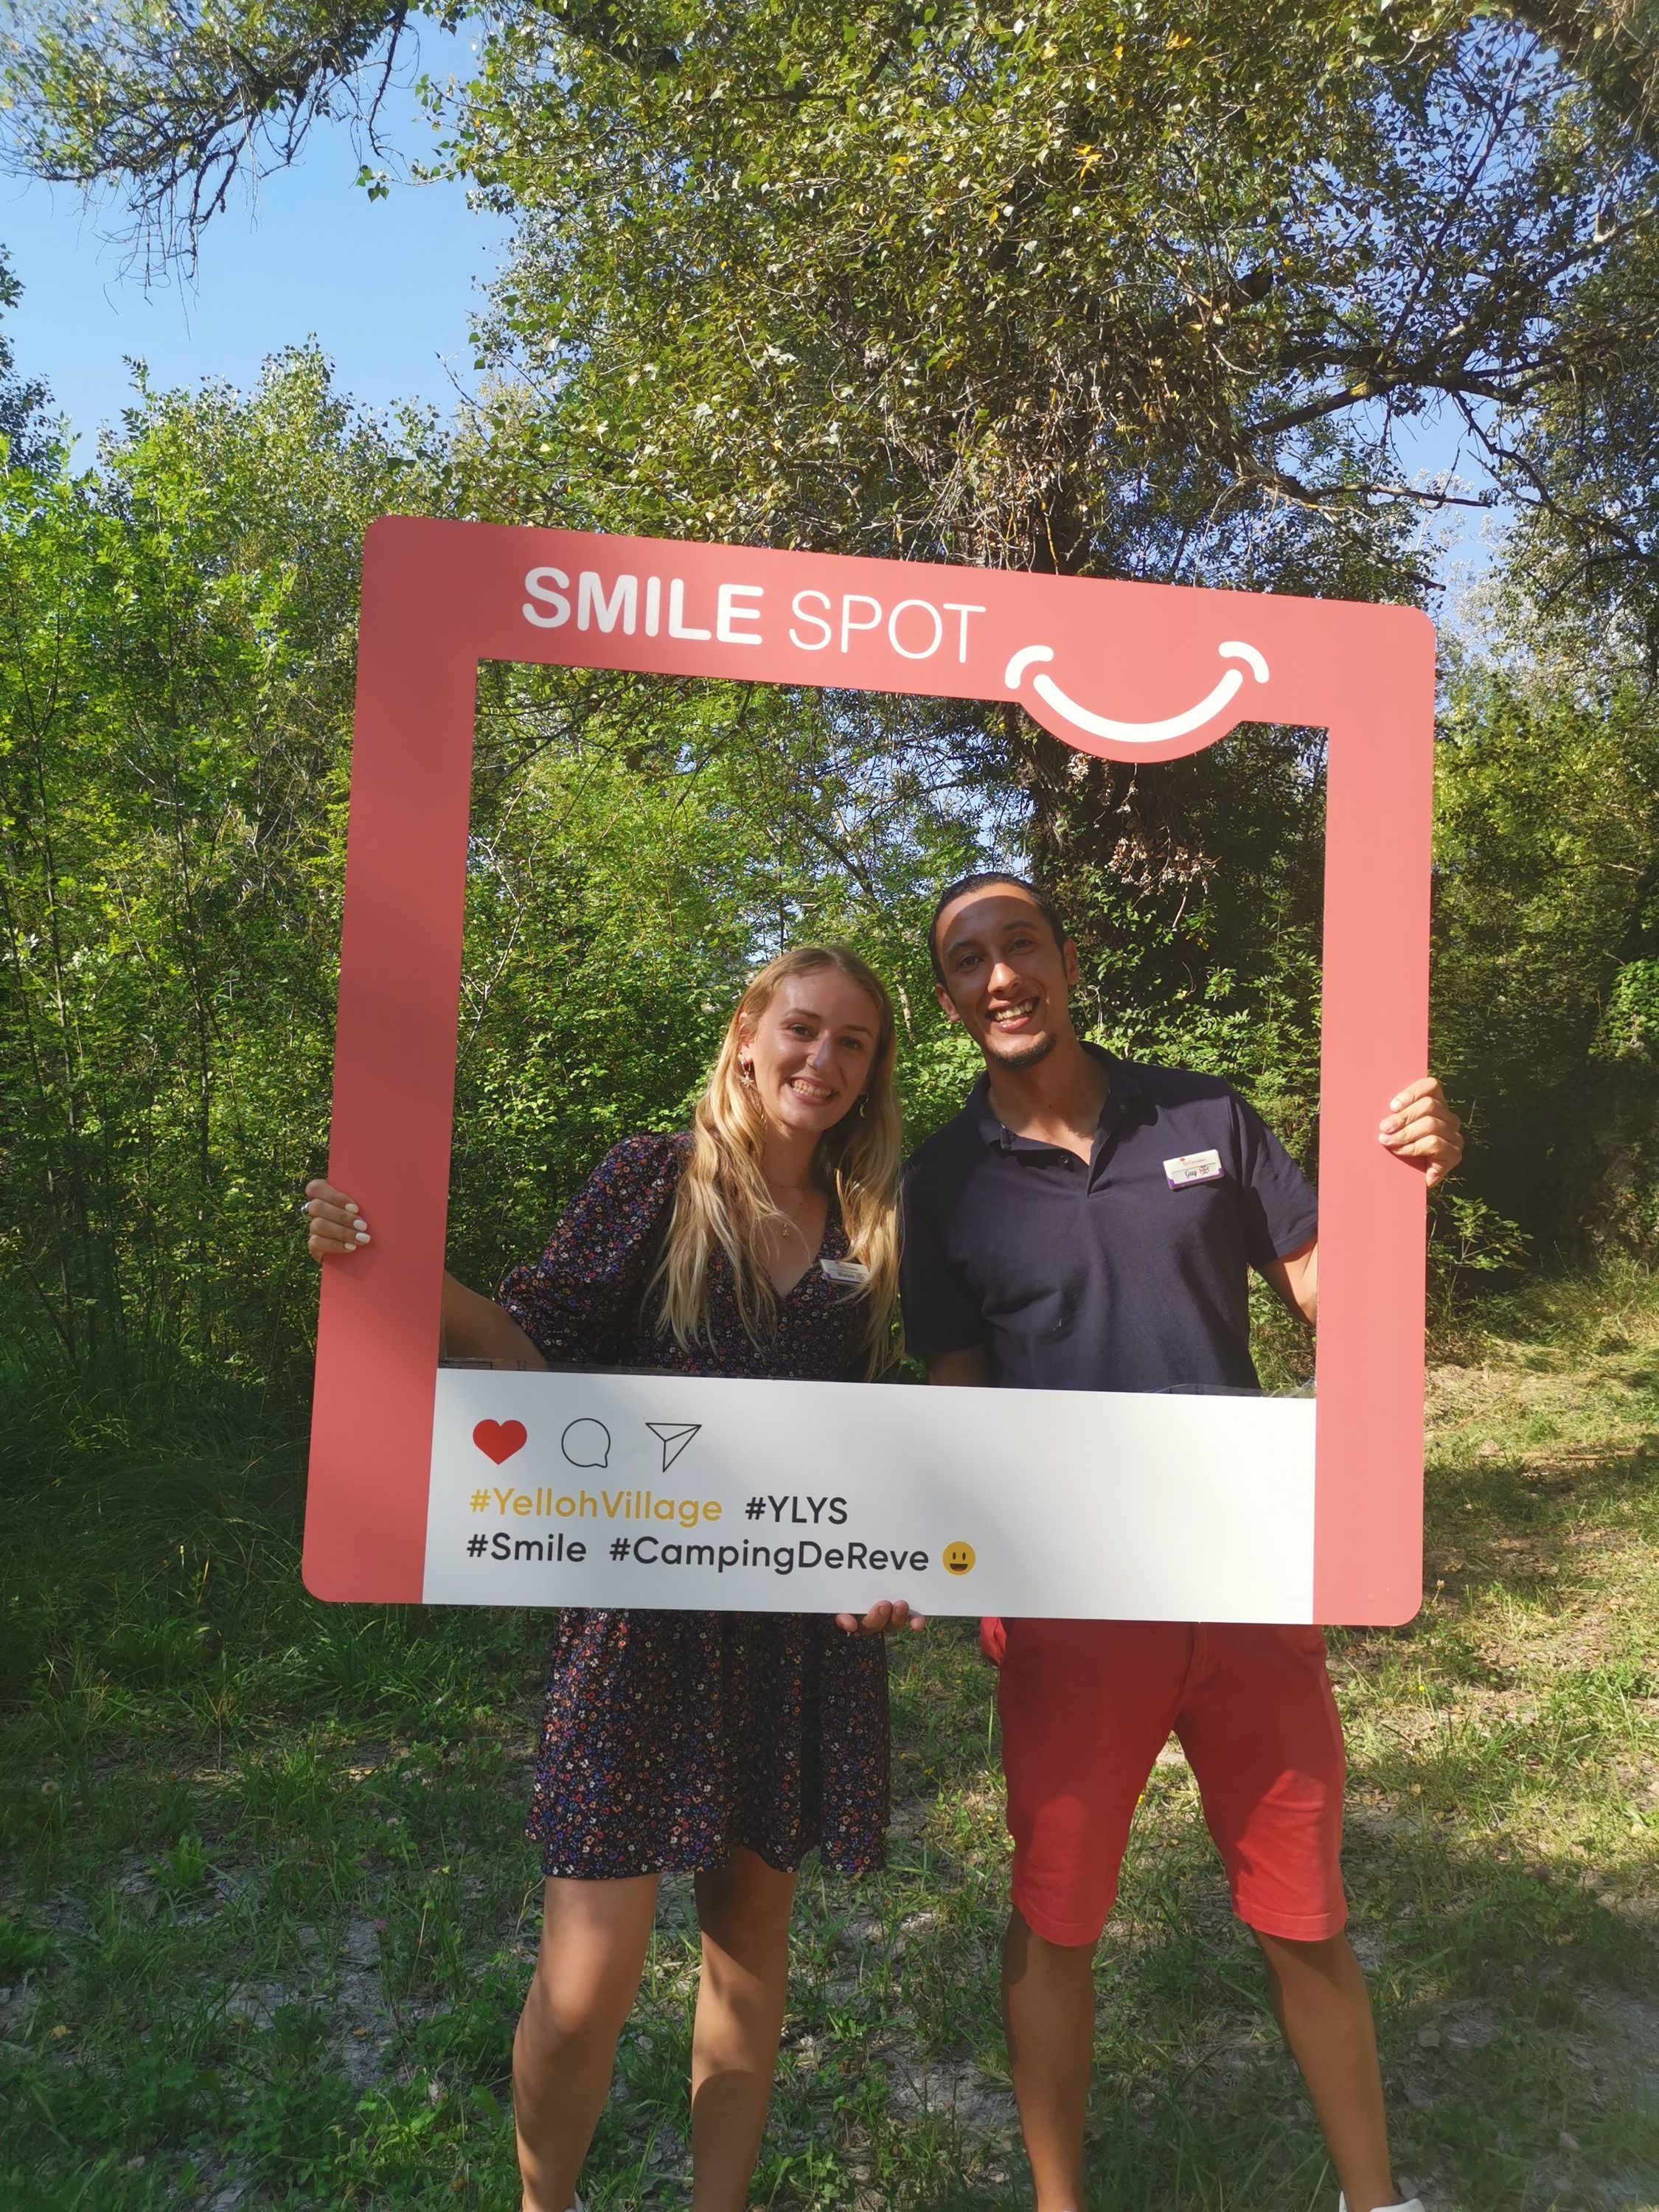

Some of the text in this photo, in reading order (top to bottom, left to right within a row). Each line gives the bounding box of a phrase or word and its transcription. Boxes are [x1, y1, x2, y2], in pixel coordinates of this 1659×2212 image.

[522, 567, 987, 664] SMILE SPOT
[469, 1486, 848, 1528] #YellohVillage #YLYS
[466, 1531, 929, 1576] #Smile #CampingDeReve
